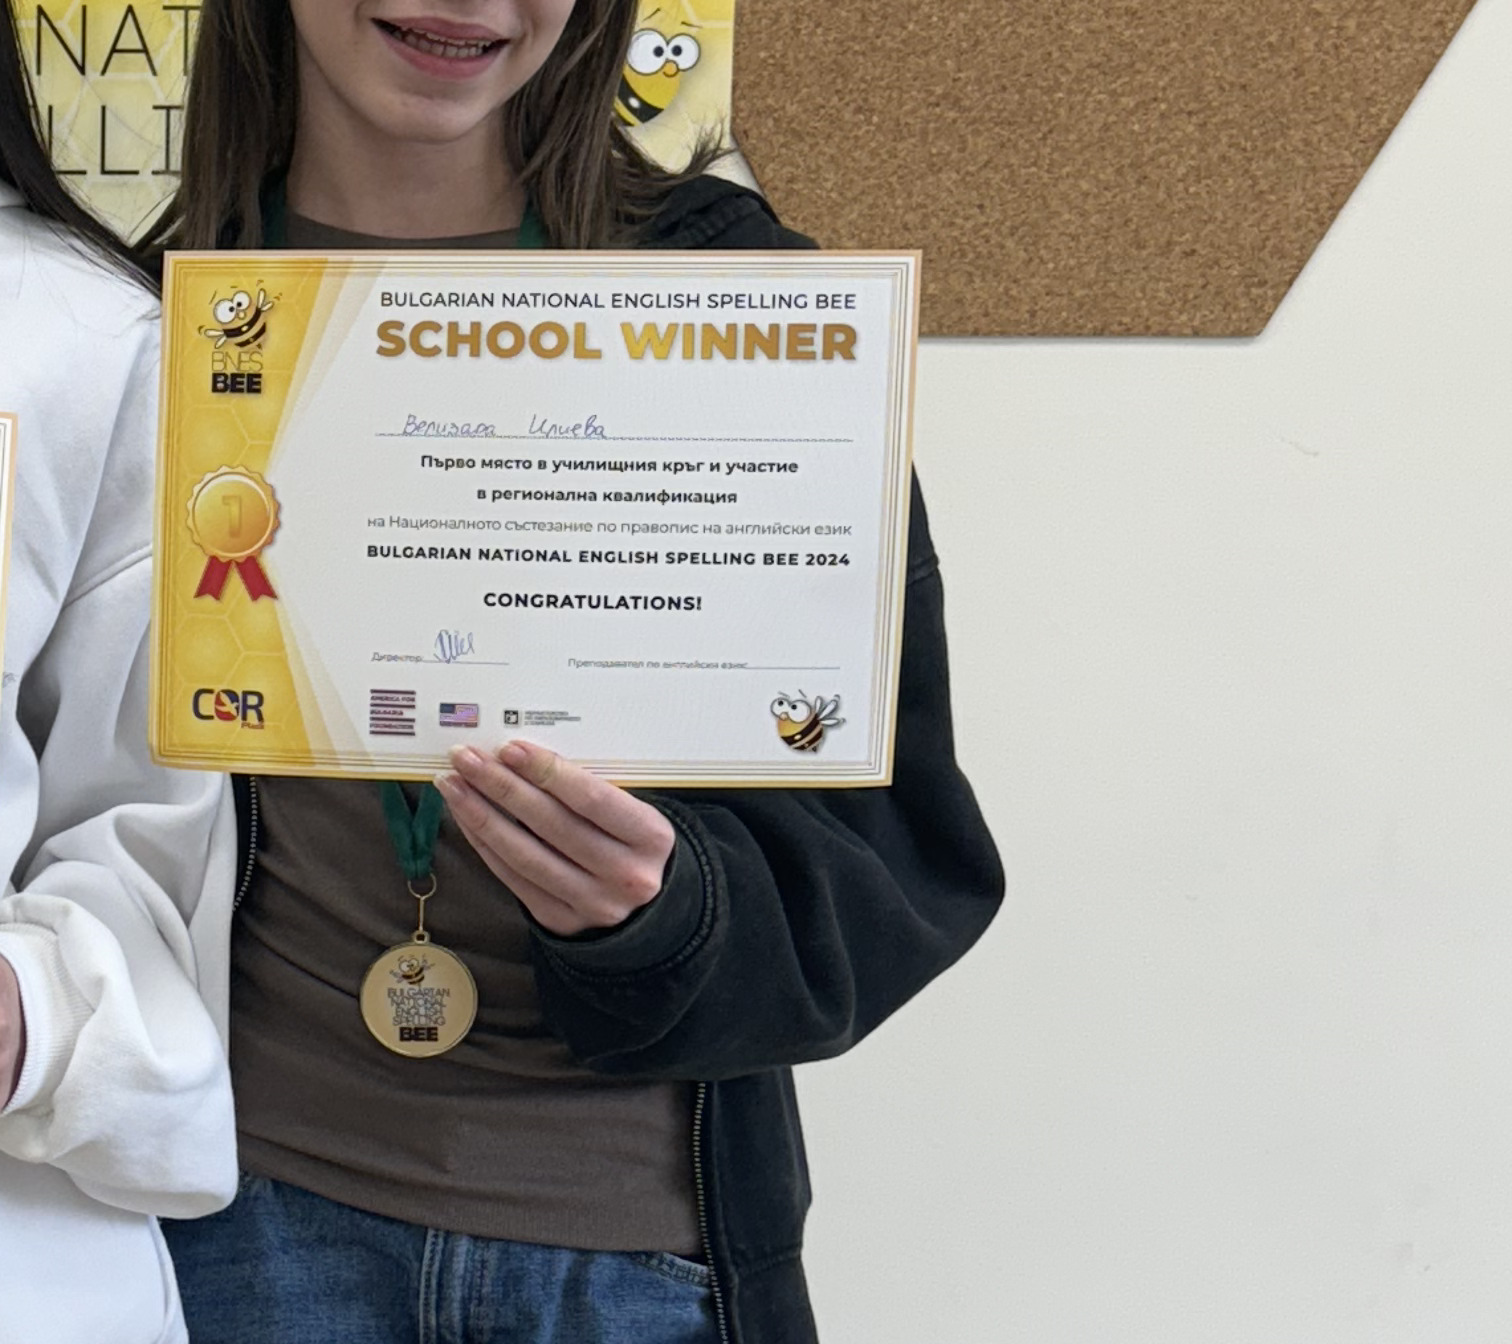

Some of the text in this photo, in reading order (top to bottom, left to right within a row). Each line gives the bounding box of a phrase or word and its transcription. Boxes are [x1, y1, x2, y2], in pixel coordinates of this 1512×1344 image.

[381, 292, 856, 310] BULGARIAN NATIONAL ENGLISH SPELLING BEE
[376, 321, 858, 361] SCHOOL WINNER
[211, 351, 264, 372] BNES
[211, 372, 263, 394] BEE
[529, 414, 606, 439] Илиева
[421, 455, 799, 476] Първо място в училищния кръг и участие
[477, 489, 737, 505] в регионална квалификация
[367, 516, 852, 537] на Националното състезание по правопис на английски език
[367, 545, 850, 566] BULGARIAN NATIONAL ENGLISH SPELLING BEE 2024
[483, 592, 702, 611] CONGRATULATIONS!
[399, 1027, 438, 1041] BEE
